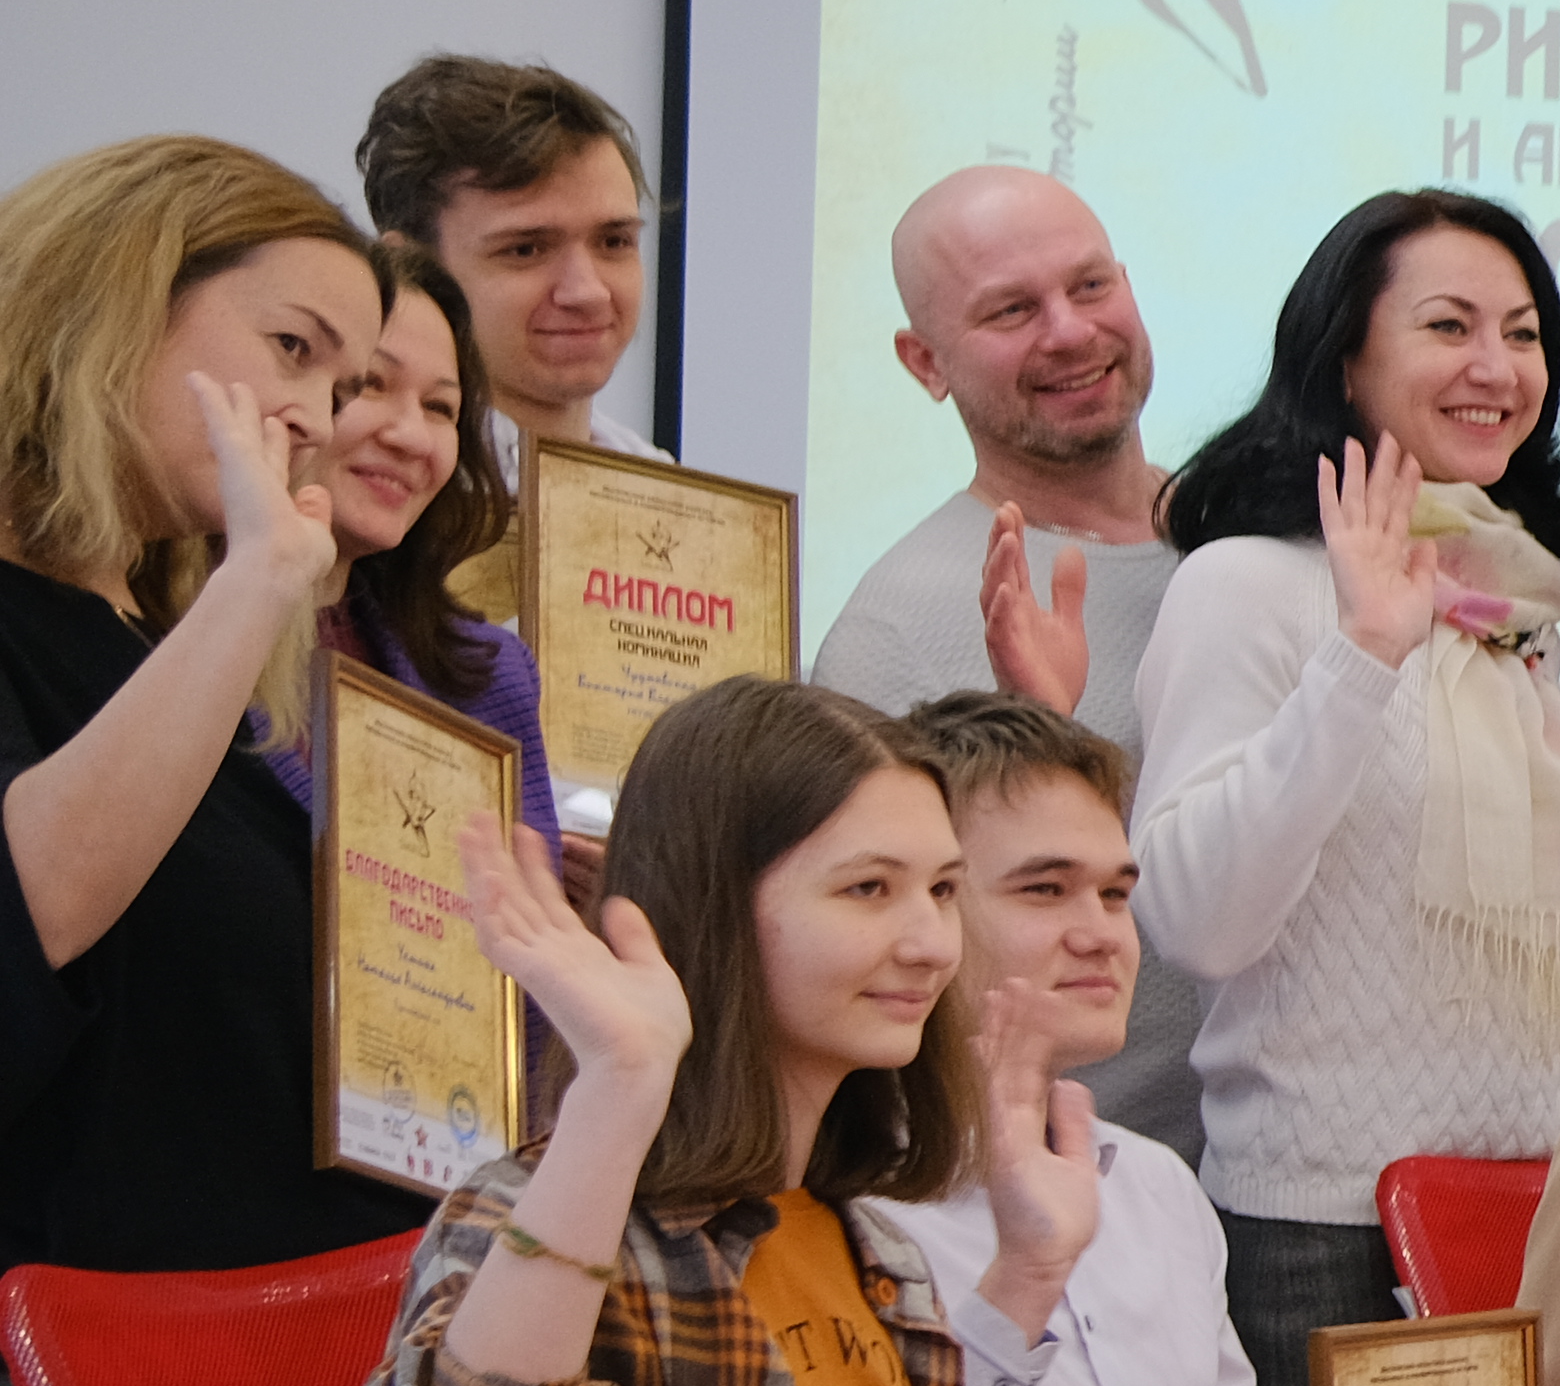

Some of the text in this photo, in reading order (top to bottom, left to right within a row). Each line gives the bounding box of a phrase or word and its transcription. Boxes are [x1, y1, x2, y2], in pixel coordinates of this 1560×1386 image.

[1441, 118, 1480, 181] И
[583, 568, 733, 633] ДИПЛОМ
[609, 618, 708, 653] СПЕЦИАЛЬНАЯ
[617, 637, 700, 669] НОМИНАЦИЯ
